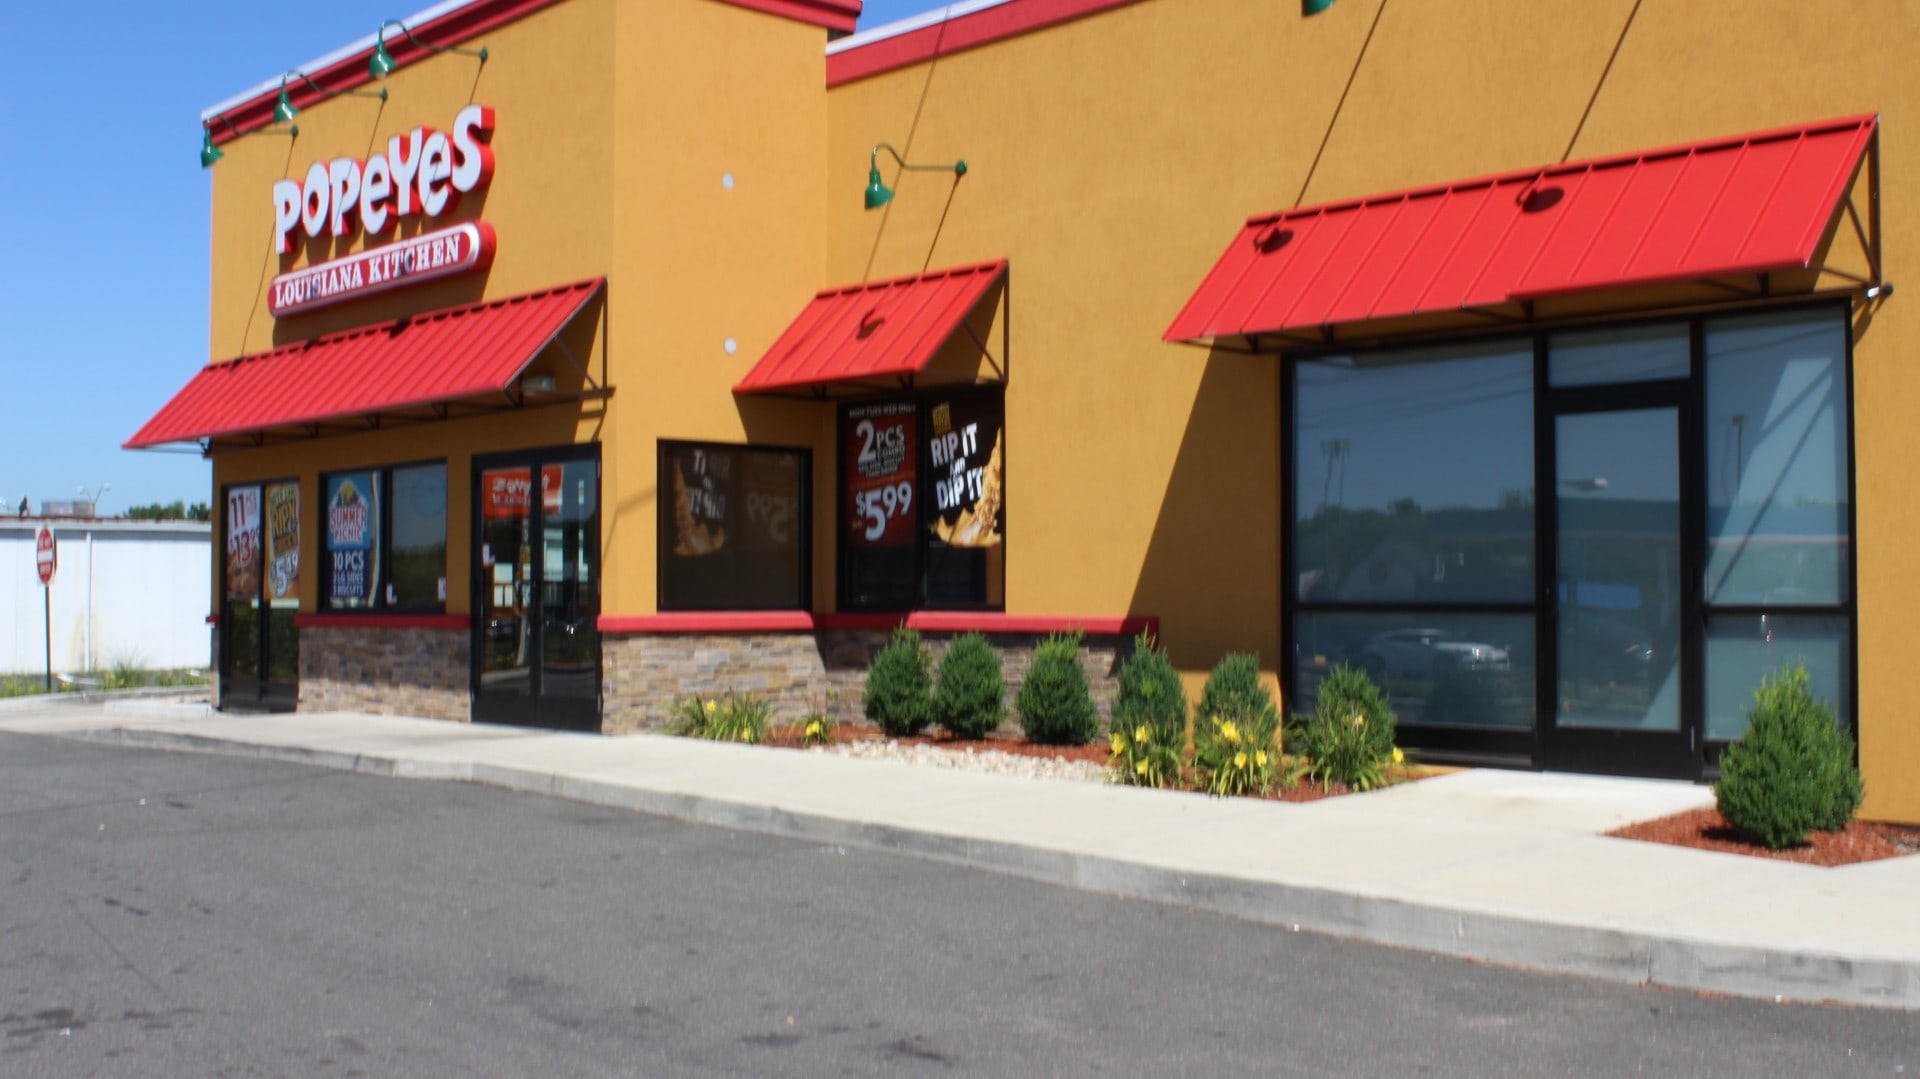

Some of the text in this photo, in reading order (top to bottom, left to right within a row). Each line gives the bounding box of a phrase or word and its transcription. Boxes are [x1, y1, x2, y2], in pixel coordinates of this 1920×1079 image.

[275, 235, 461, 308] LOUISIANA KITCHEN
[856, 418, 905, 463] 2 PCS
[930, 422, 978, 468] RIP IT
[950, 457, 966, 477] AND
[936, 466, 984, 510] DIP IT
[230, 492, 246, 529] 11
[330, 505, 367, 531] SUMMER
[855, 481, 912, 541] $599
[333, 528, 363, 544] PICNIC
[333, 550, 364, 572] 10 PCS
